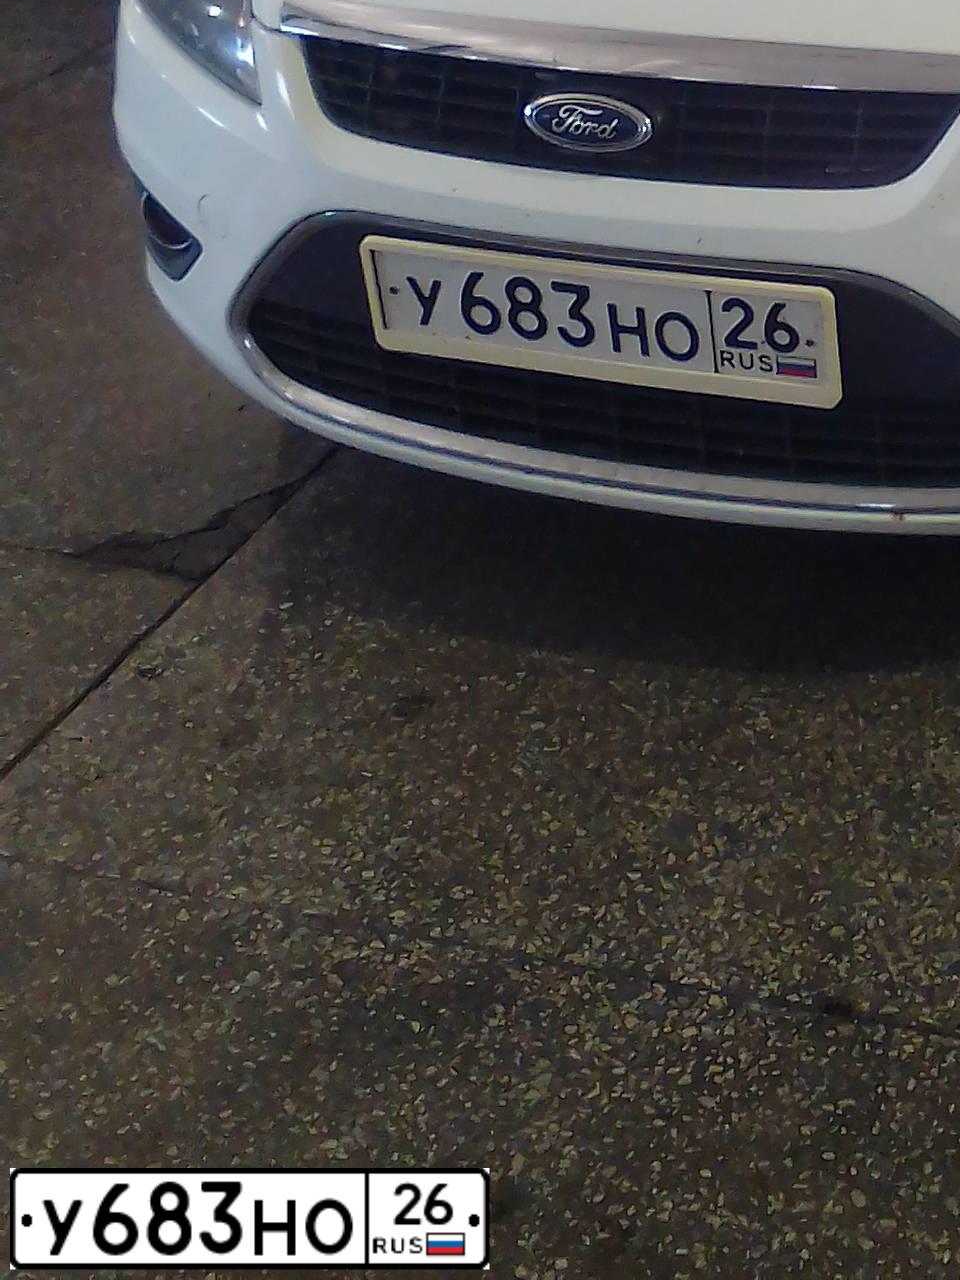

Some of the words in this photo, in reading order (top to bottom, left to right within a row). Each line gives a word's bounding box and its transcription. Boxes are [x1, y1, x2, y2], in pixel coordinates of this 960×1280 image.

[552, 104, 619, 139] Ford
[721, 297, 800, 354] 26
[720, 349, 774, 373] RUS
